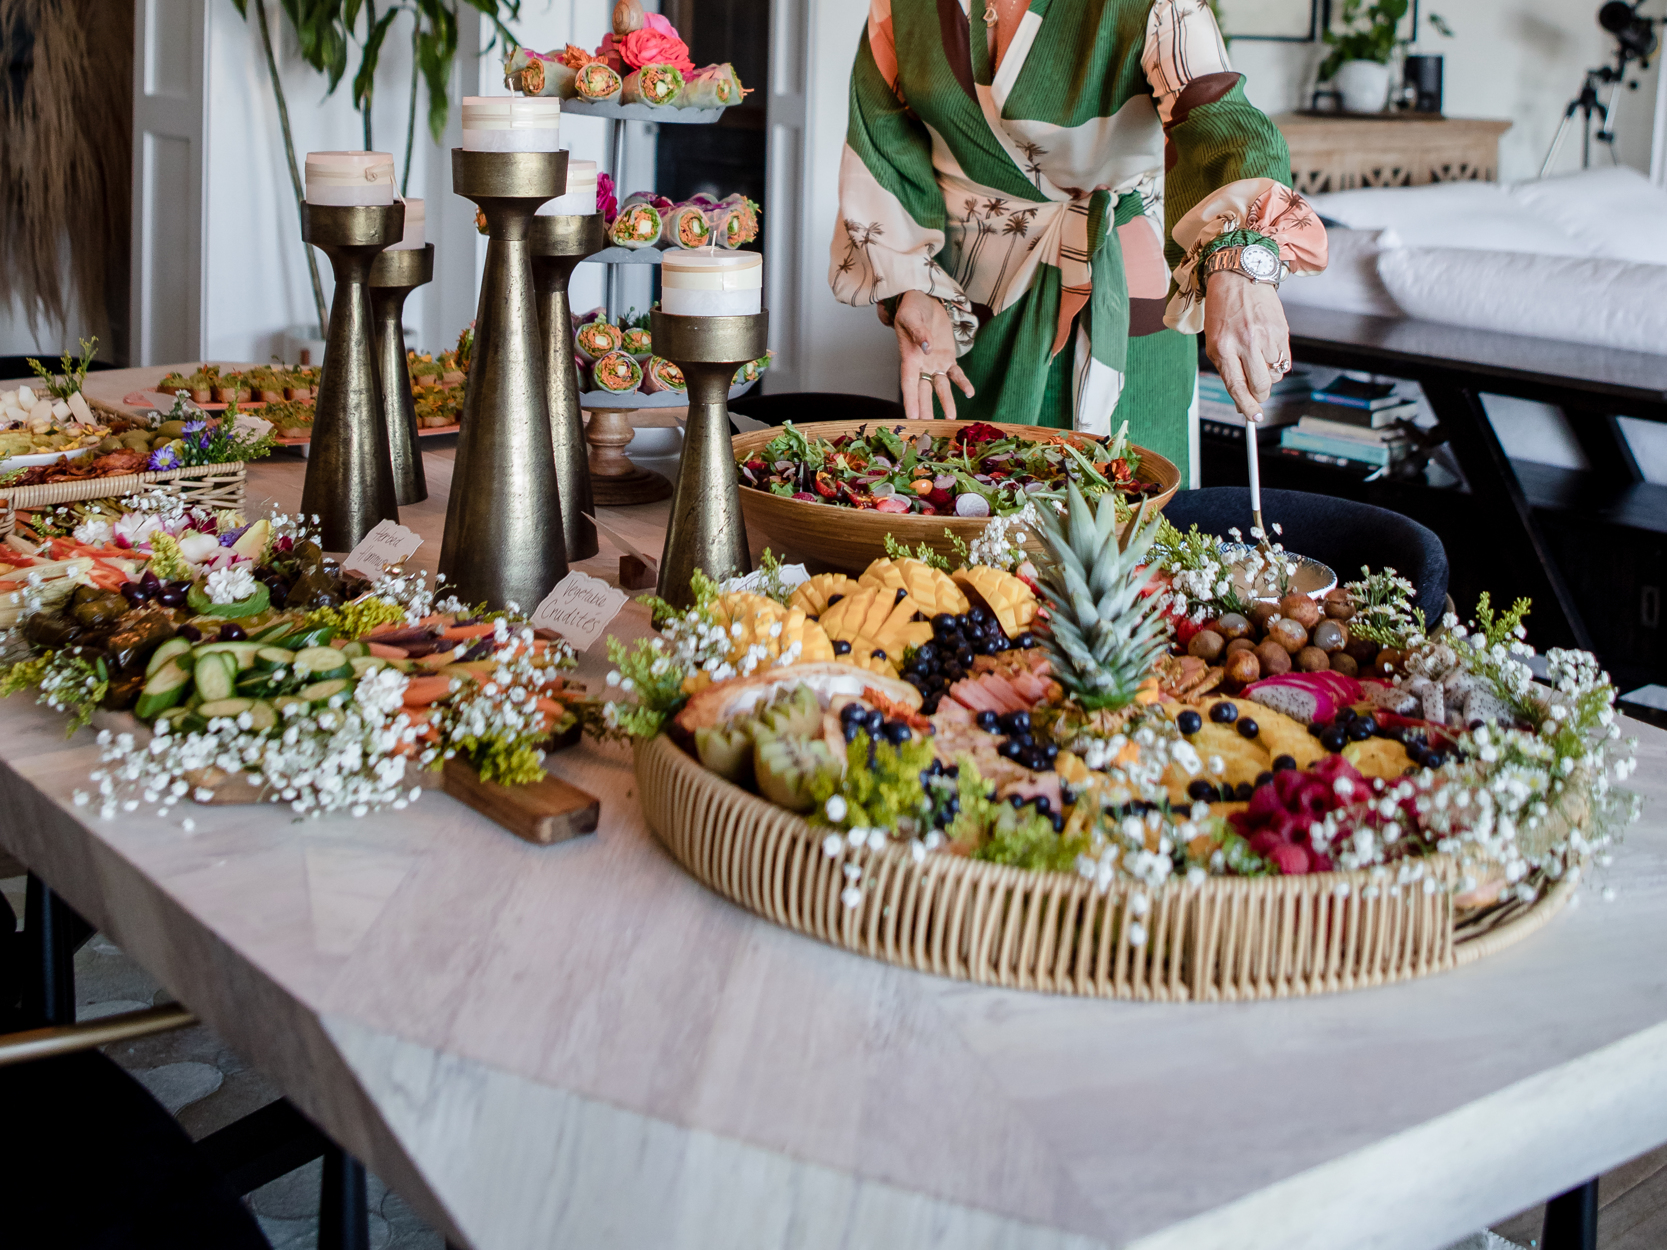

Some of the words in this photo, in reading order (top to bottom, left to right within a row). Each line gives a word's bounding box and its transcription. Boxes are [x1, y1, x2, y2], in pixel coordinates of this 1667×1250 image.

[373, 527, 405, 547] Herbed
[563, 579, 606, 604] Vegetable
[541, 599, 601, 633] Crudités
